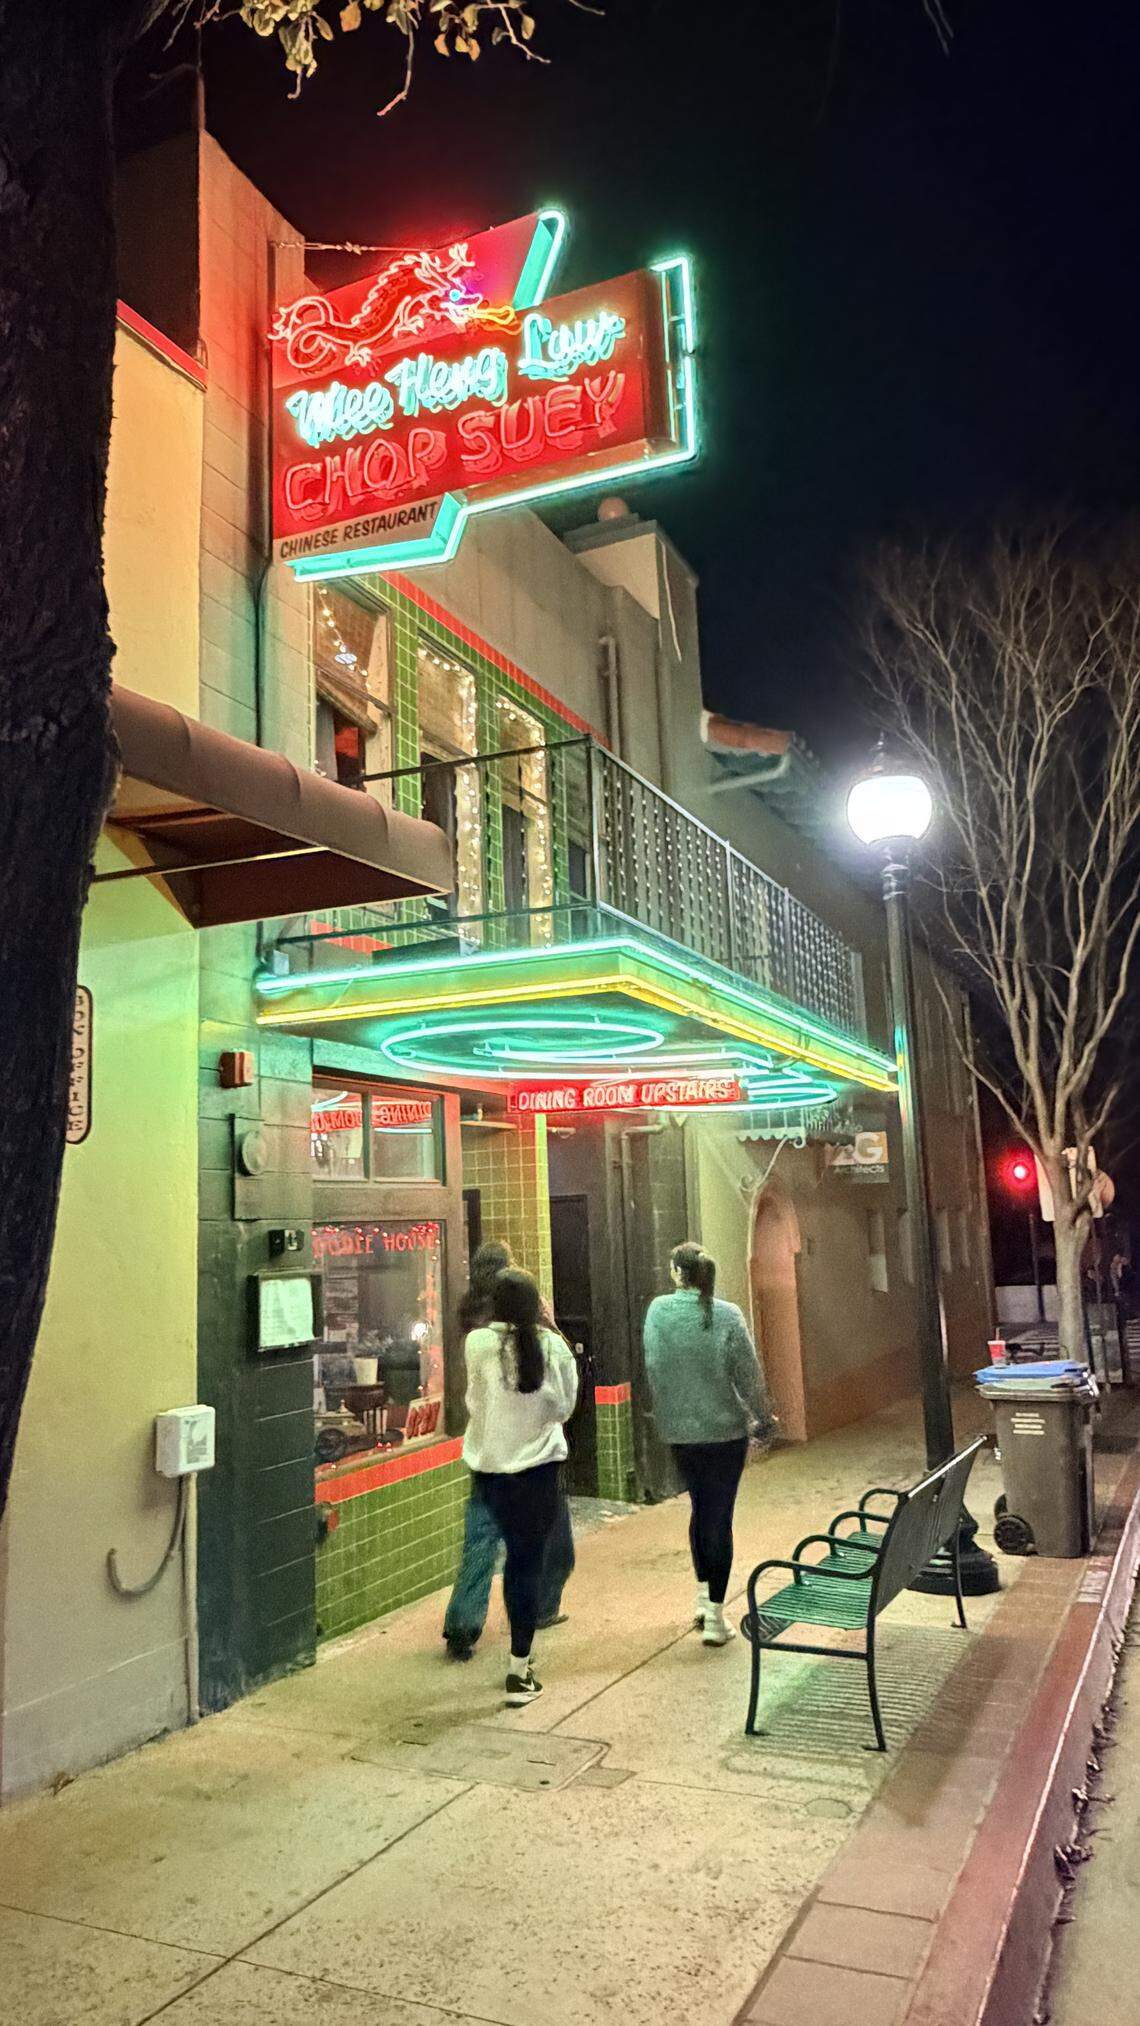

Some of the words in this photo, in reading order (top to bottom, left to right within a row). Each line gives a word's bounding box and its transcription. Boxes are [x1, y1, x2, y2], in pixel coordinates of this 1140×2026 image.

[385, 346, 508, 418] Heng
[519, 310, 627, 382] Low
[285, 427, 447, 520] CHOP
[457, 369, 625, 473] SUEY
[280, 528, 339, 558] CHINESE
[343, 501, 438, 542] RESTAURANT
[517, 1088, 576, 1110] DINING
[583, 1084, 634, 1106] ROOM
[641, 1079, 734, 1103] UPSTAIRS
[382, 1228, 437, 1252] HOUSE
